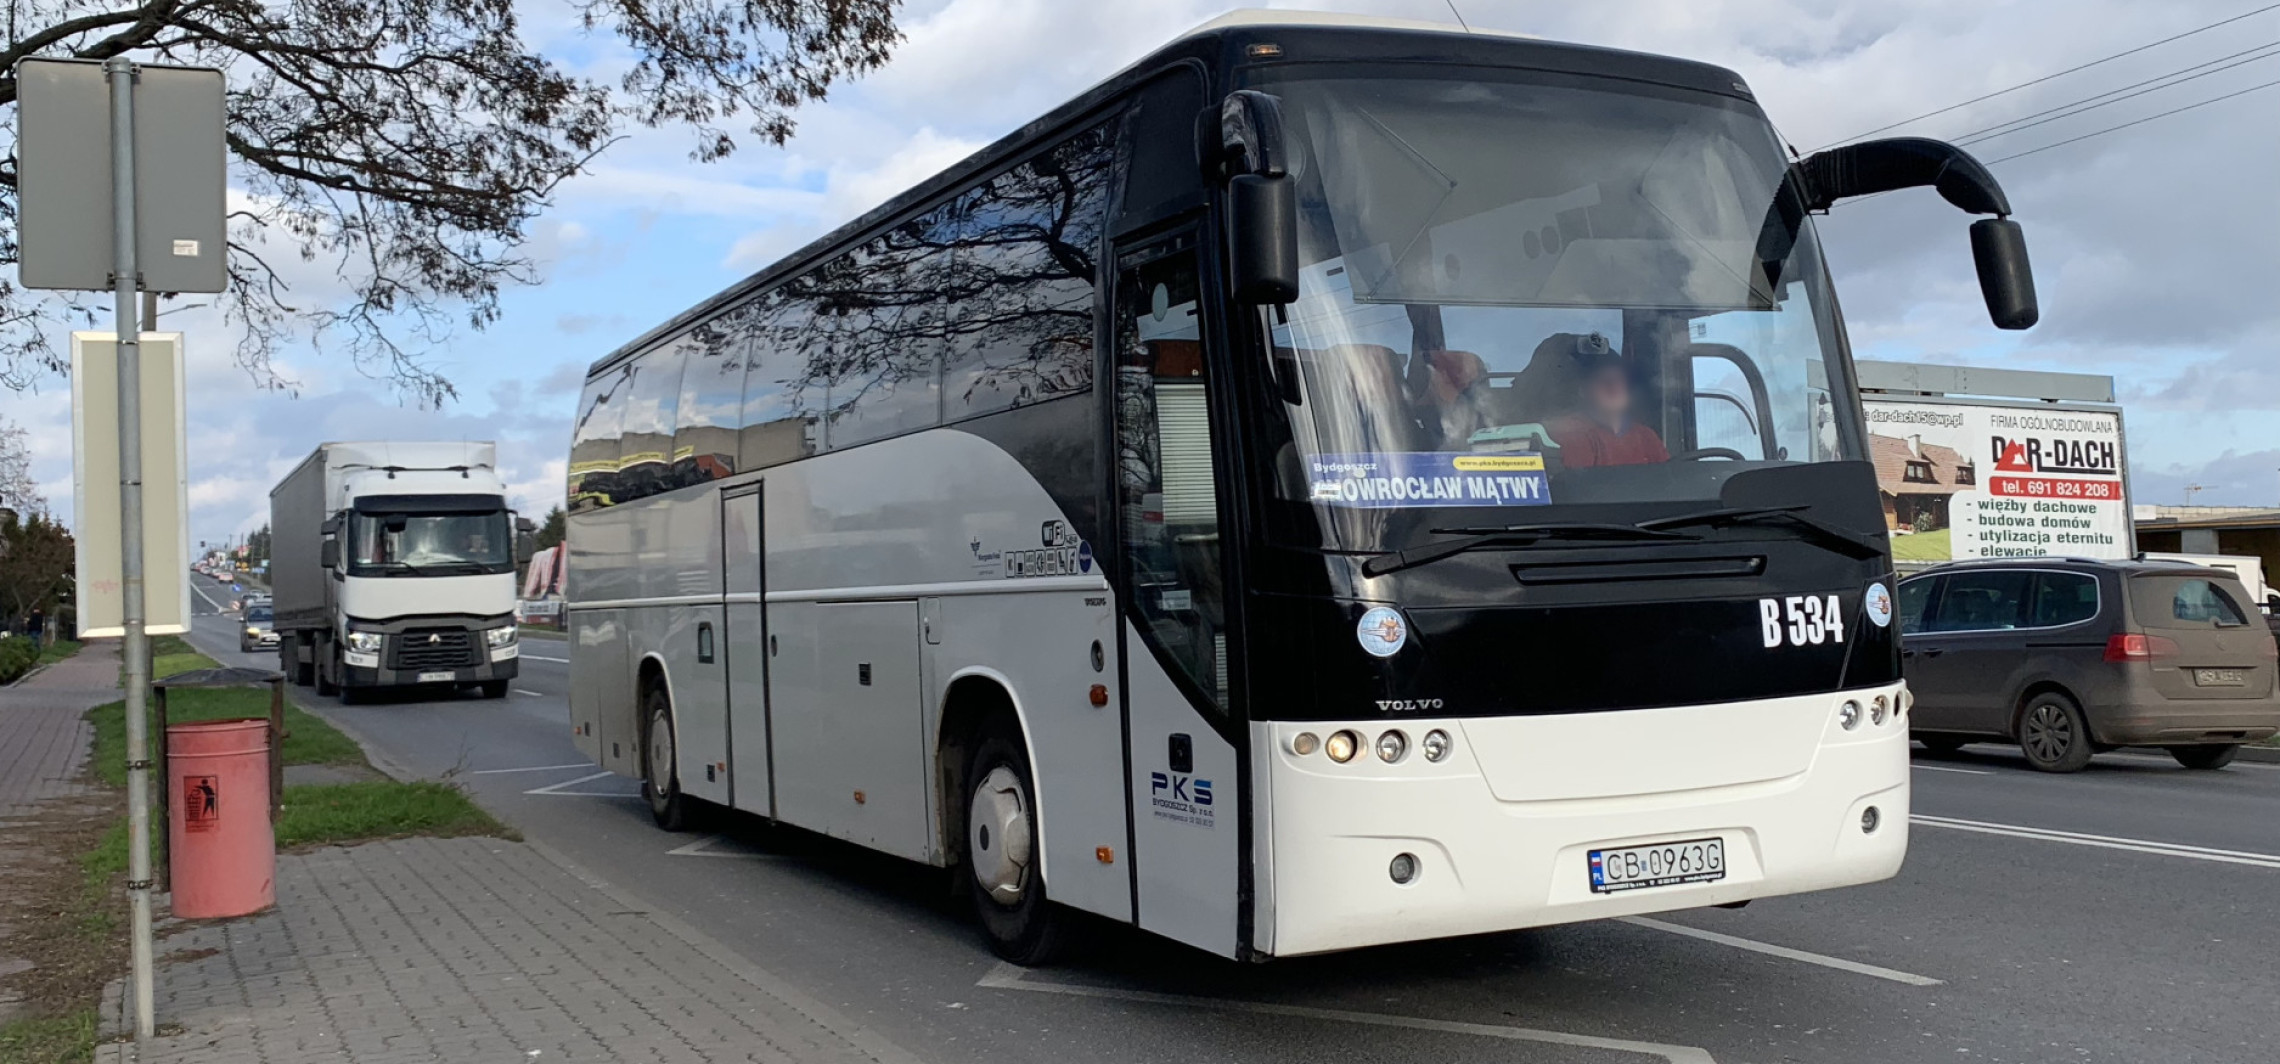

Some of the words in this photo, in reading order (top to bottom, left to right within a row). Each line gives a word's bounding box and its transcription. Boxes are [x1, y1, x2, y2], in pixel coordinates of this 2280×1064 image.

[1991, 415, 2018, 429] FIRMA
[2020, 415, 2112, 433] OGÓLNOBUDOWLANA
[1467, 477, 1540, 504] MĄTWY
[2002, 479, 2024, 494] tel.
[2027, 481, 2051, 495] 691
[2056, 482, 2080, 496] 824
[2085, 483, 2109, 497] 208
[1978, 499, 2027, 513] więźby
[2033, 500, 2097, 514] dachowe
[1979, 514, 2035, 527] budowa
[2041, 515, 2091, 529] domów
[1980, 529, 2050, 545] utylizacja
[2056, 532, 2113, 545] eternitu
[1759, 598, 1782, 648] B
[1785, 594, 1844, 646] 534
[1375, 698, 1444, 711] VOLVO
[1151, 771, 1213, 806] PKS
[1607, 852, 1640, 880] CB
[1650, 843, 1719, 876] 0963G
